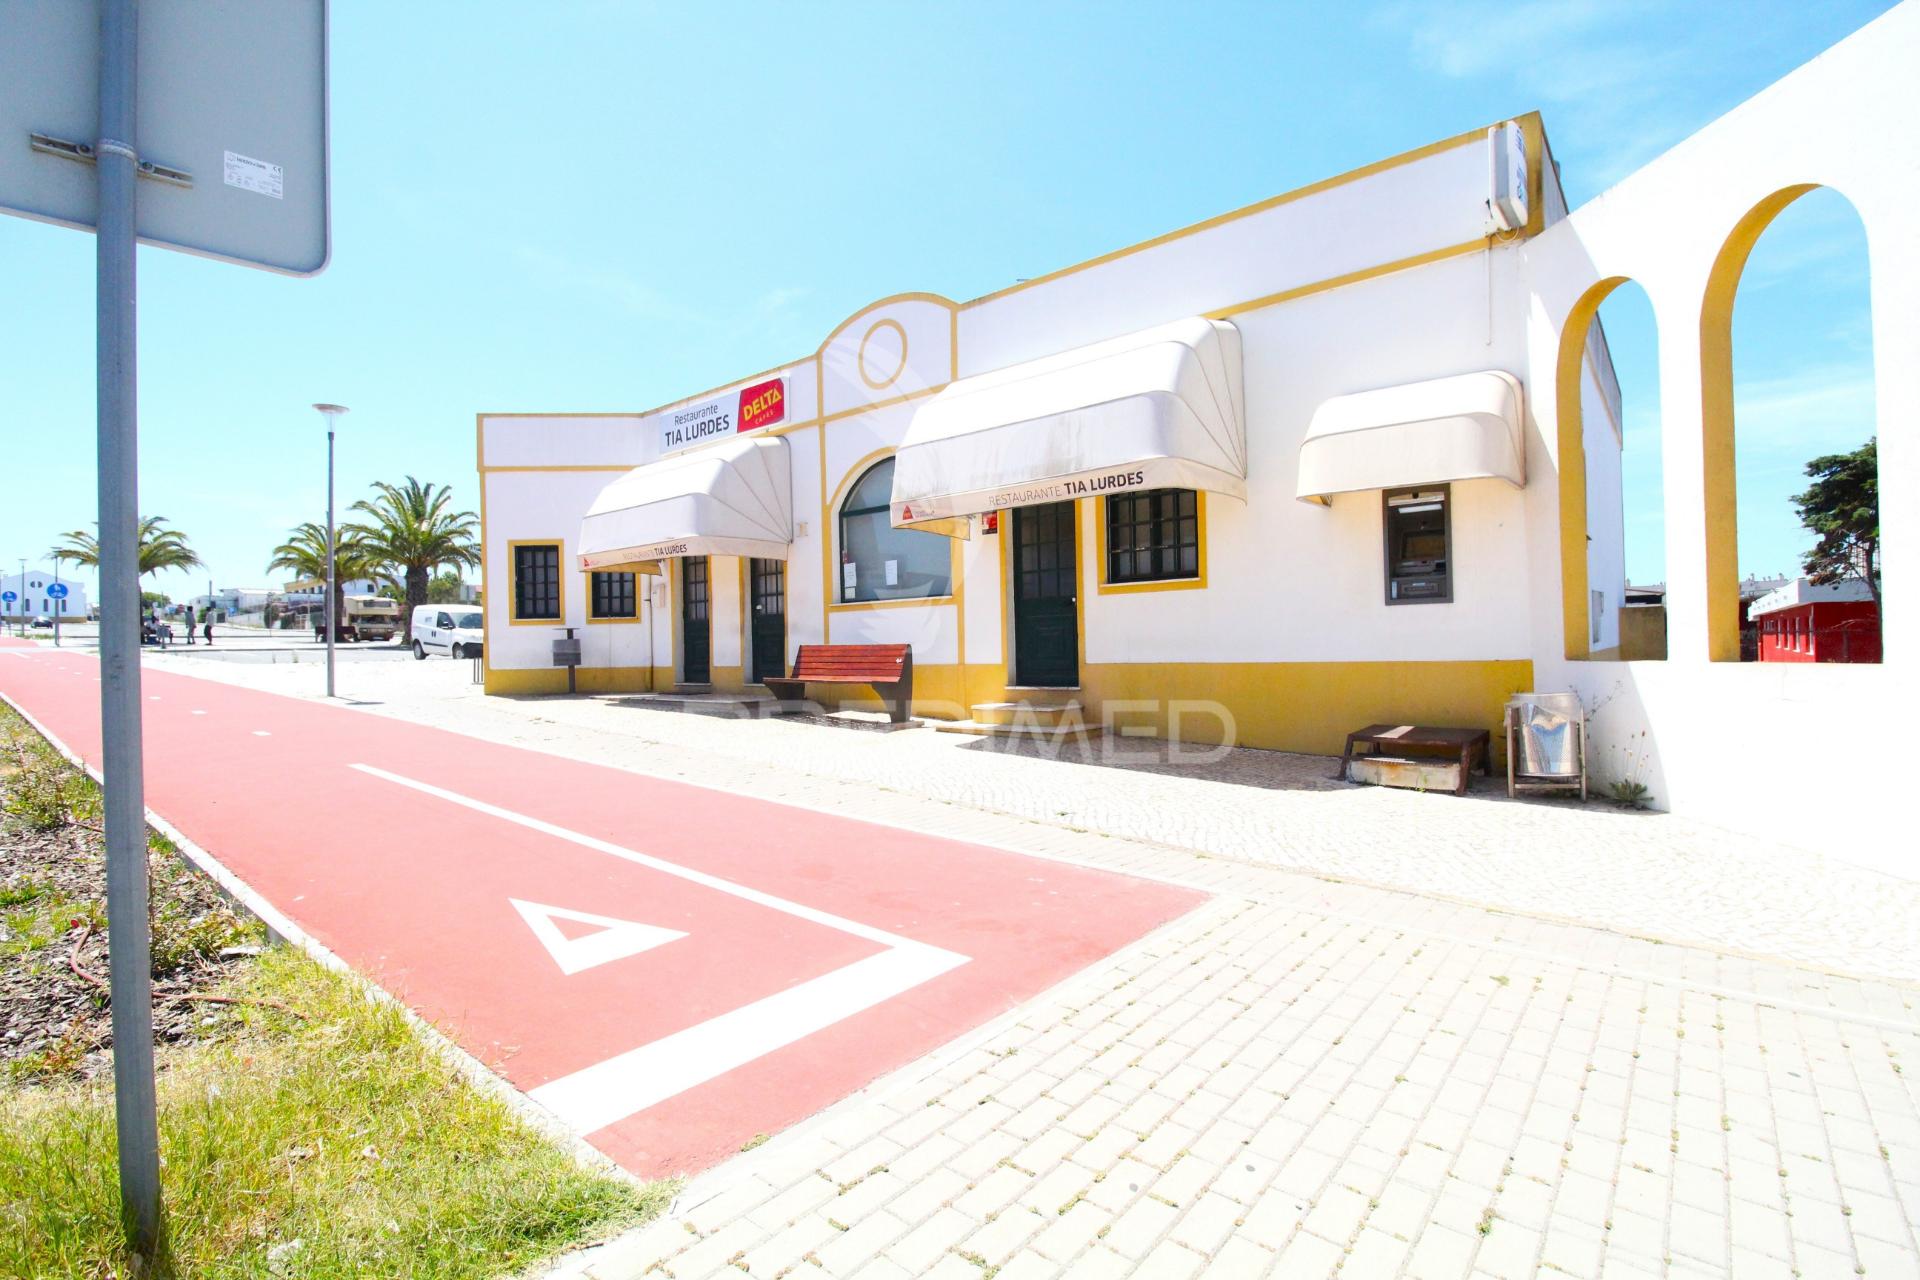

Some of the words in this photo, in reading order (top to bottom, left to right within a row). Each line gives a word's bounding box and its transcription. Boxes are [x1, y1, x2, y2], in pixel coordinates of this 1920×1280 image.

[674, 404, 719, 426] Restaurante
[743, 387, 782, 421] DELTA
[665, 428, 686, 447] TIA
[686, 414, 730, 442] LURDES
[988, 485, 1063, 506] RESTAURANTE
[1064, 480, 1087, 495] TIA
[1090, 471, 1144, 491] LURDES
[654, 547, 664, 556] TIA
[664, 544, 688, 555] LURDES
